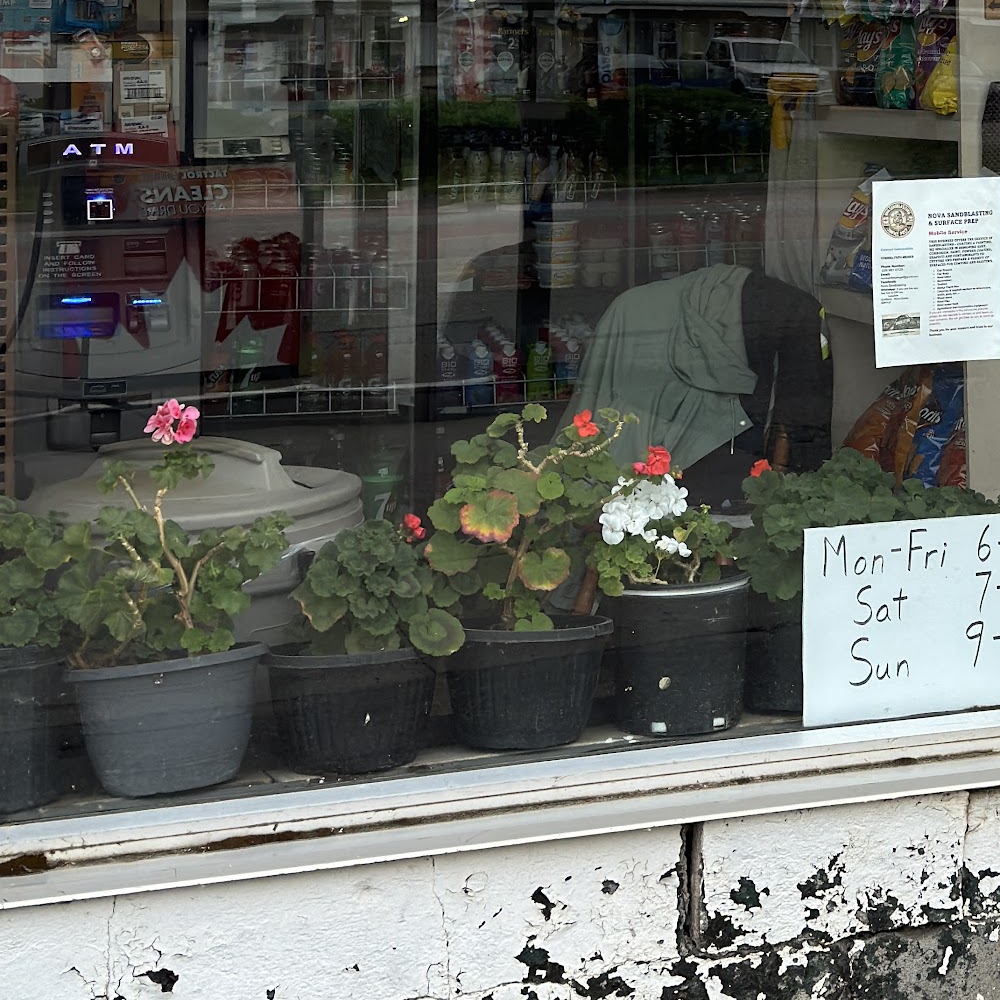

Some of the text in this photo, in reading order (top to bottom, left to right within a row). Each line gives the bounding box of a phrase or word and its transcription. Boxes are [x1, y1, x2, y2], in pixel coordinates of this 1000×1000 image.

[63, 143, 134, 155] ATM
[947, 209, 993, 218] SANDBLASTING
[823, 528, 948, 577] Mon-Fri
[853, 584, 908, 626] Sat
[849, 637, 910, 686] Sun
